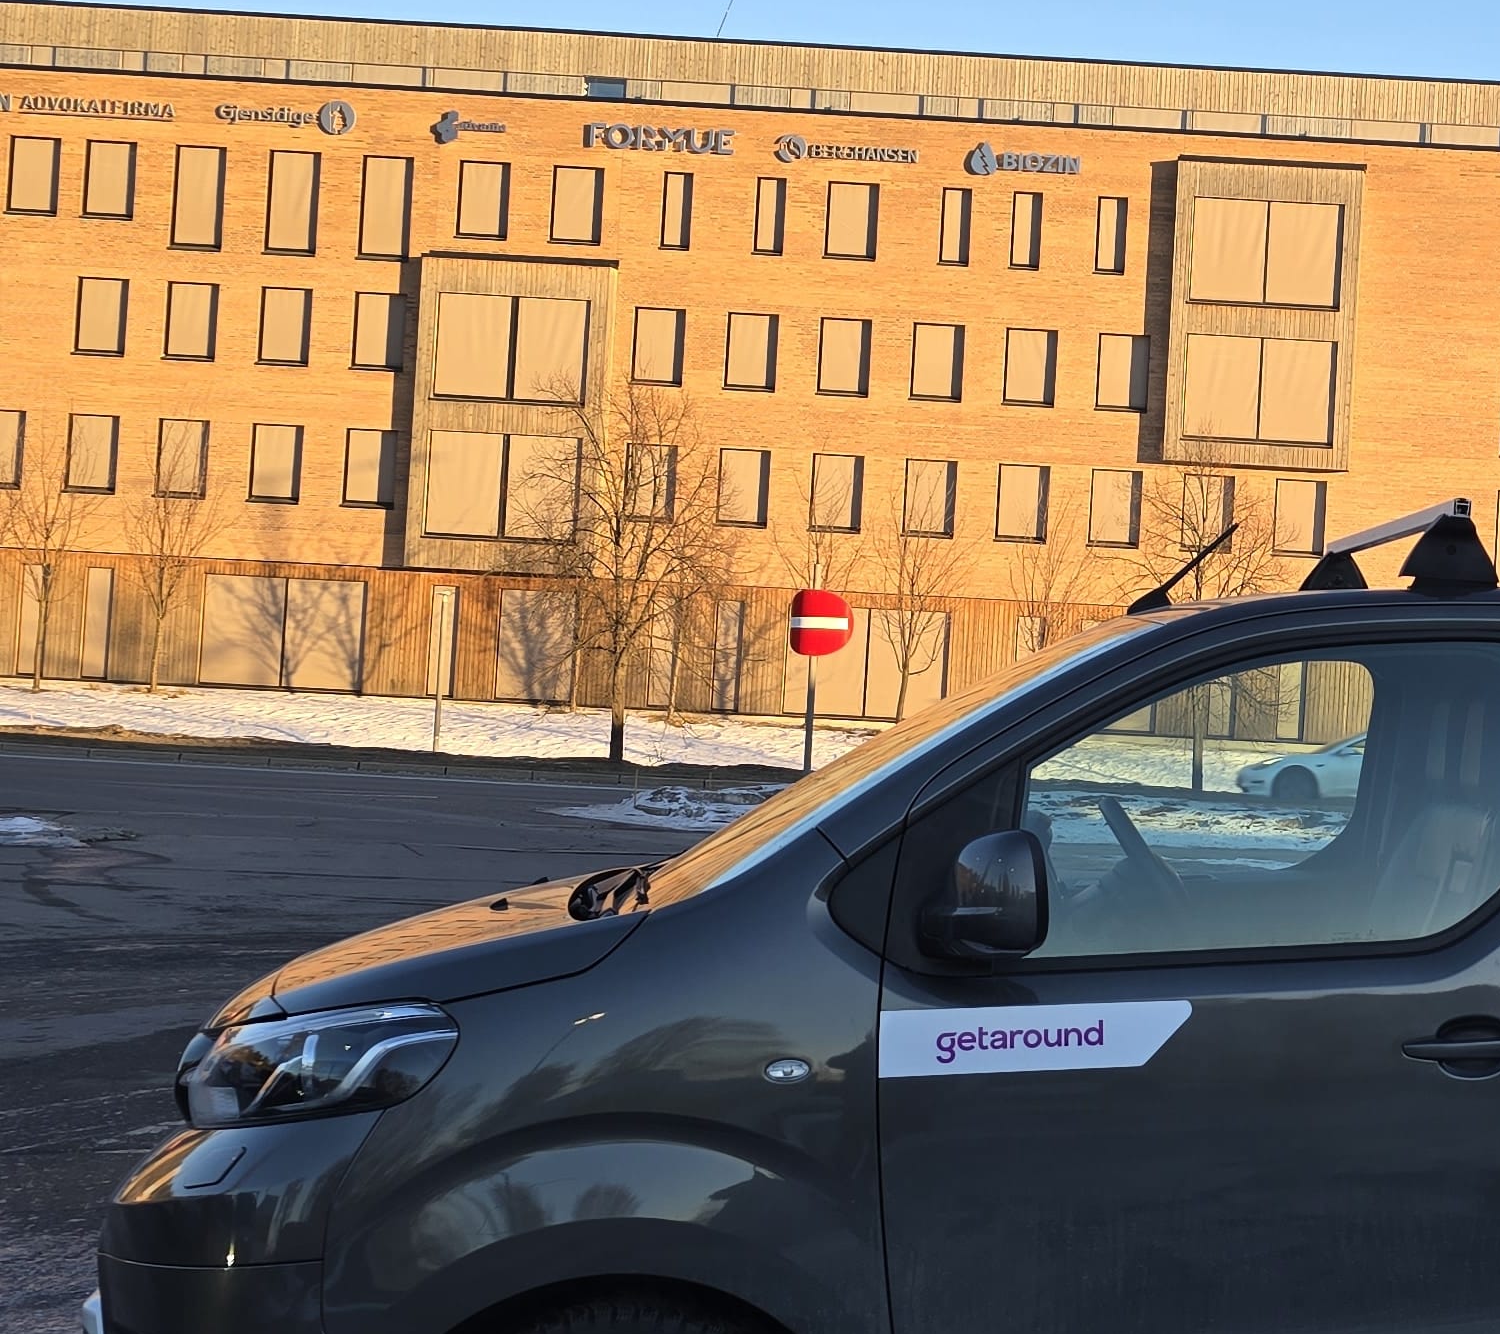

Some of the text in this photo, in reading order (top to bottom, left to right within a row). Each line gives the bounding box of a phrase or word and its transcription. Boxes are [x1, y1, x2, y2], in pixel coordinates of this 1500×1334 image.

[19, 94, 176, 118] ADVOKATFIRMA
[215, 103, 320, 128] Gjensidige
[583, 123, 735, 155] FORMUE
[997, 152, 1081, 175] BIOZIN
[936, 1019, 1104, 1064] getaround
